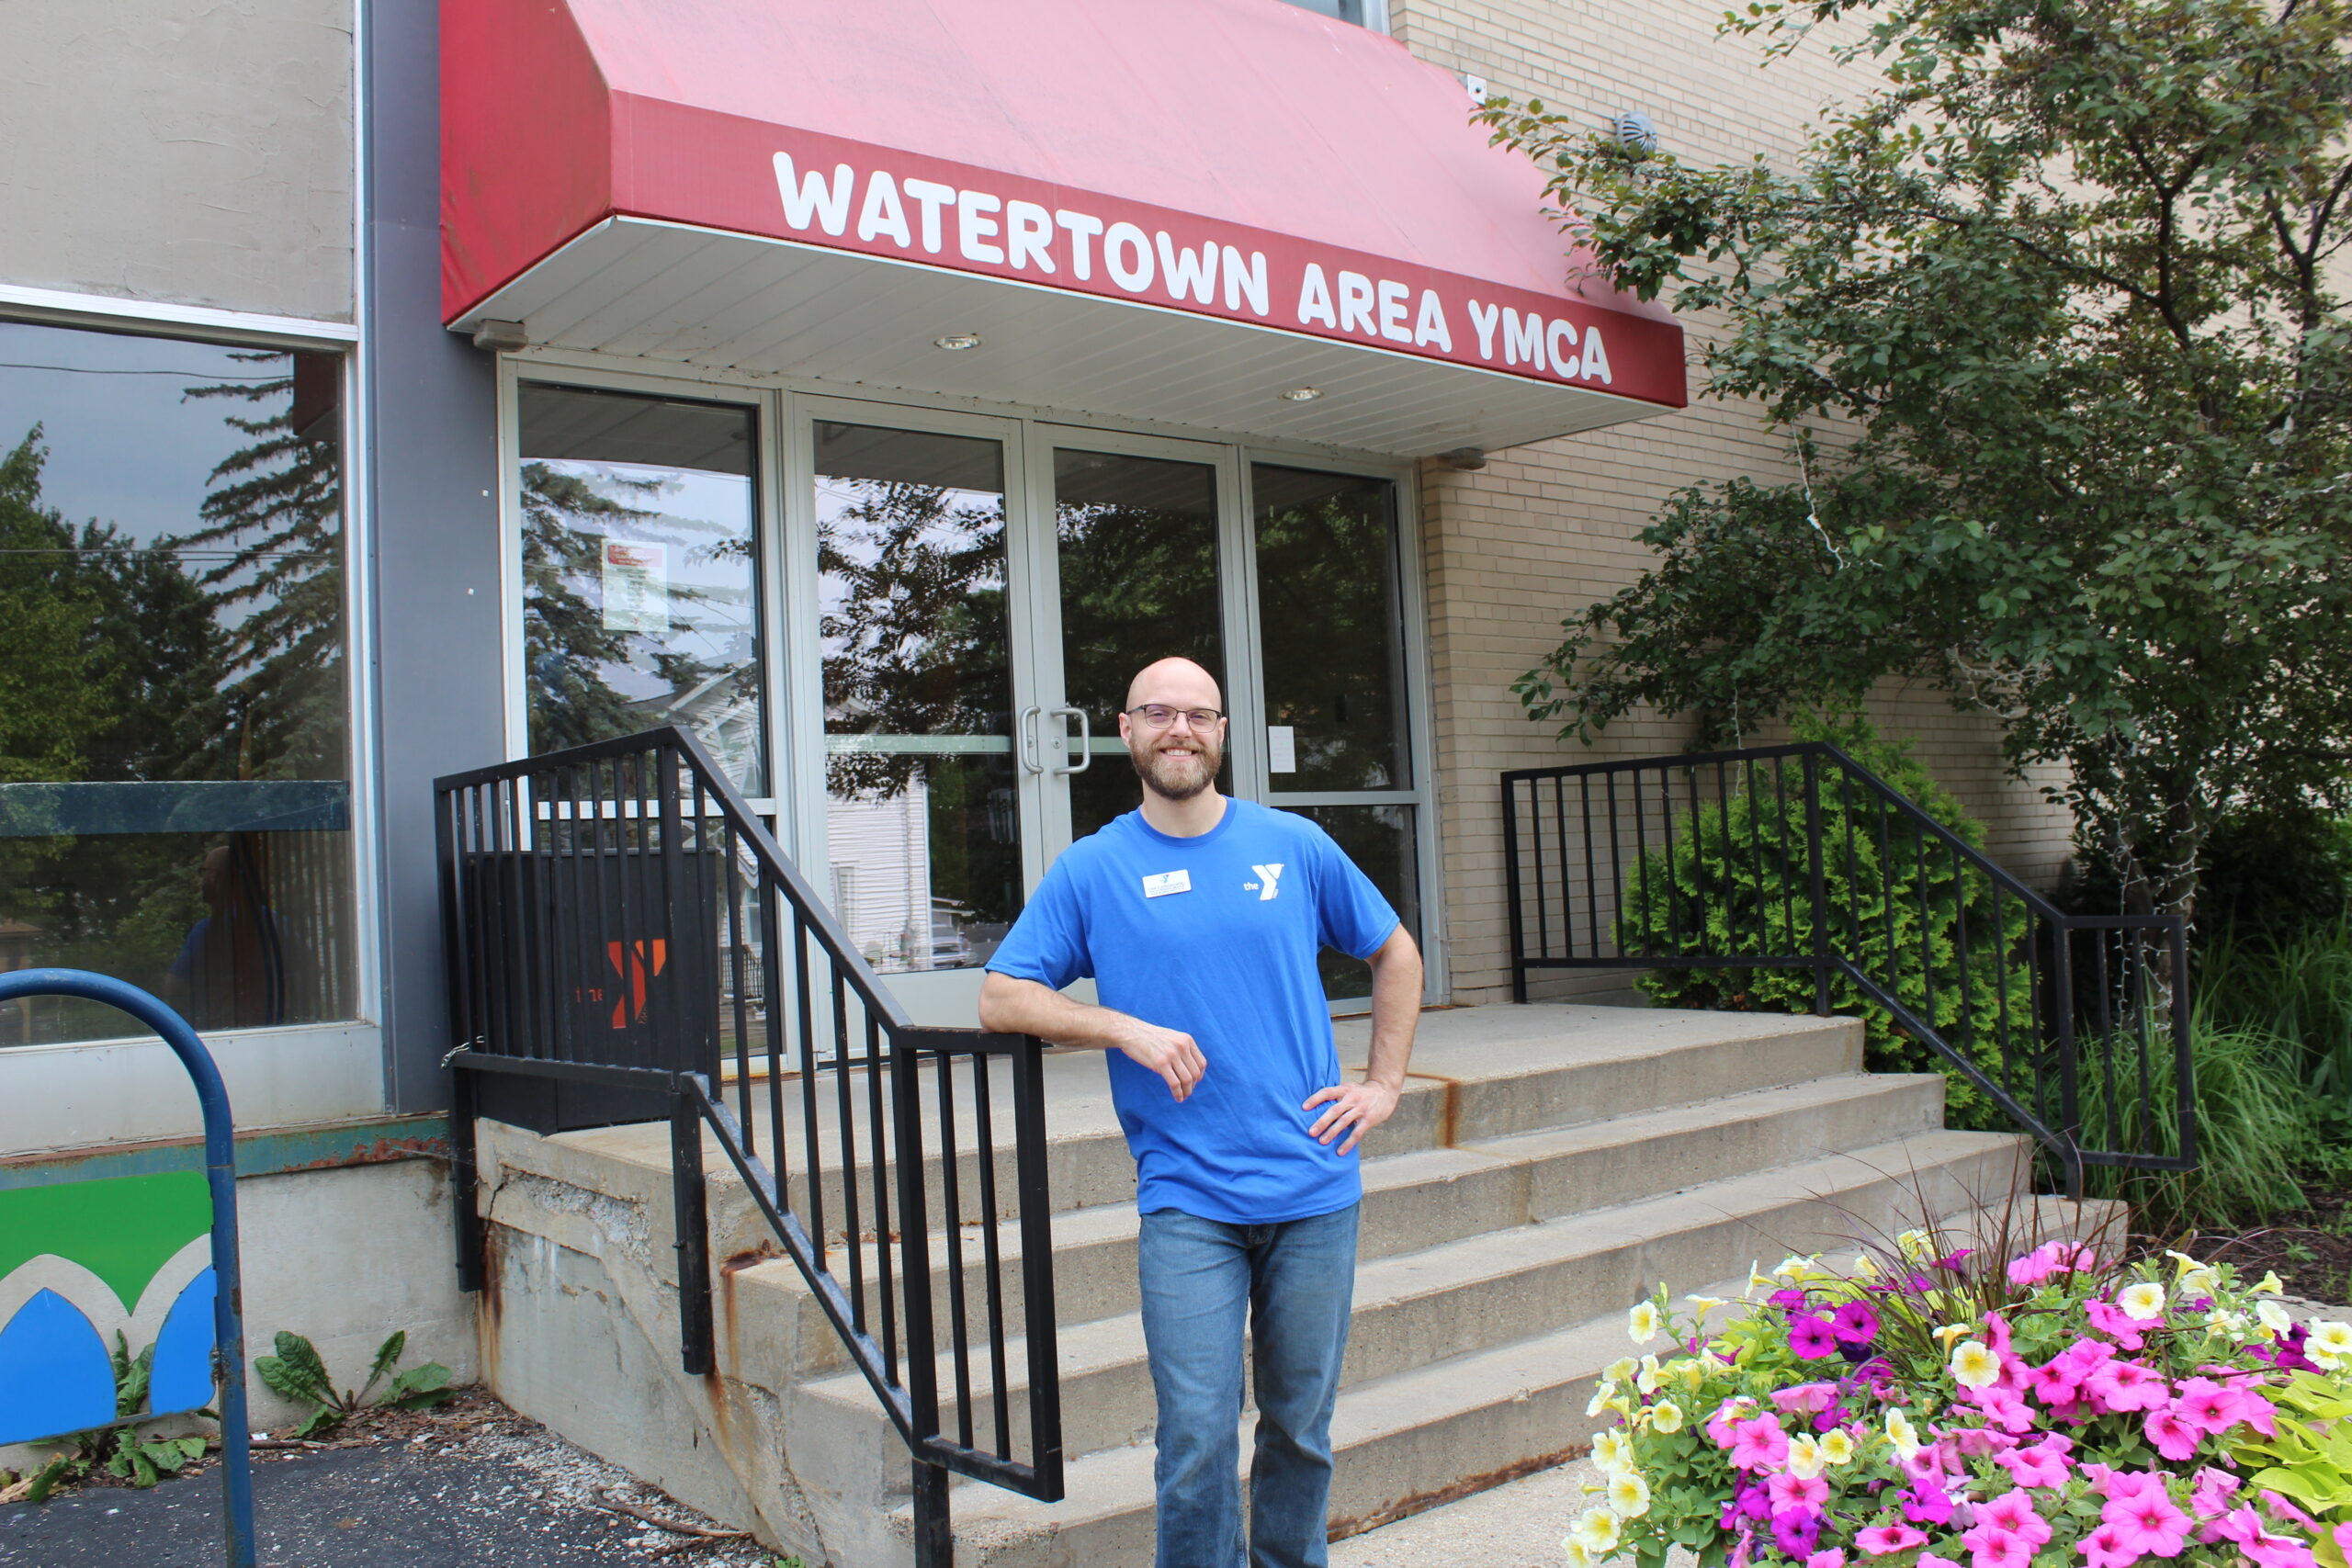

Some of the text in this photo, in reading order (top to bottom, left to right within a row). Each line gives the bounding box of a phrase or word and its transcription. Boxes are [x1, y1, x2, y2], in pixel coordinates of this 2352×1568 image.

[773, 151, 1612, 385] WATERTOWN AREA YMCA
[1243, 881, 1259, 891] the
[1251, 863, 1283, 901] Y
